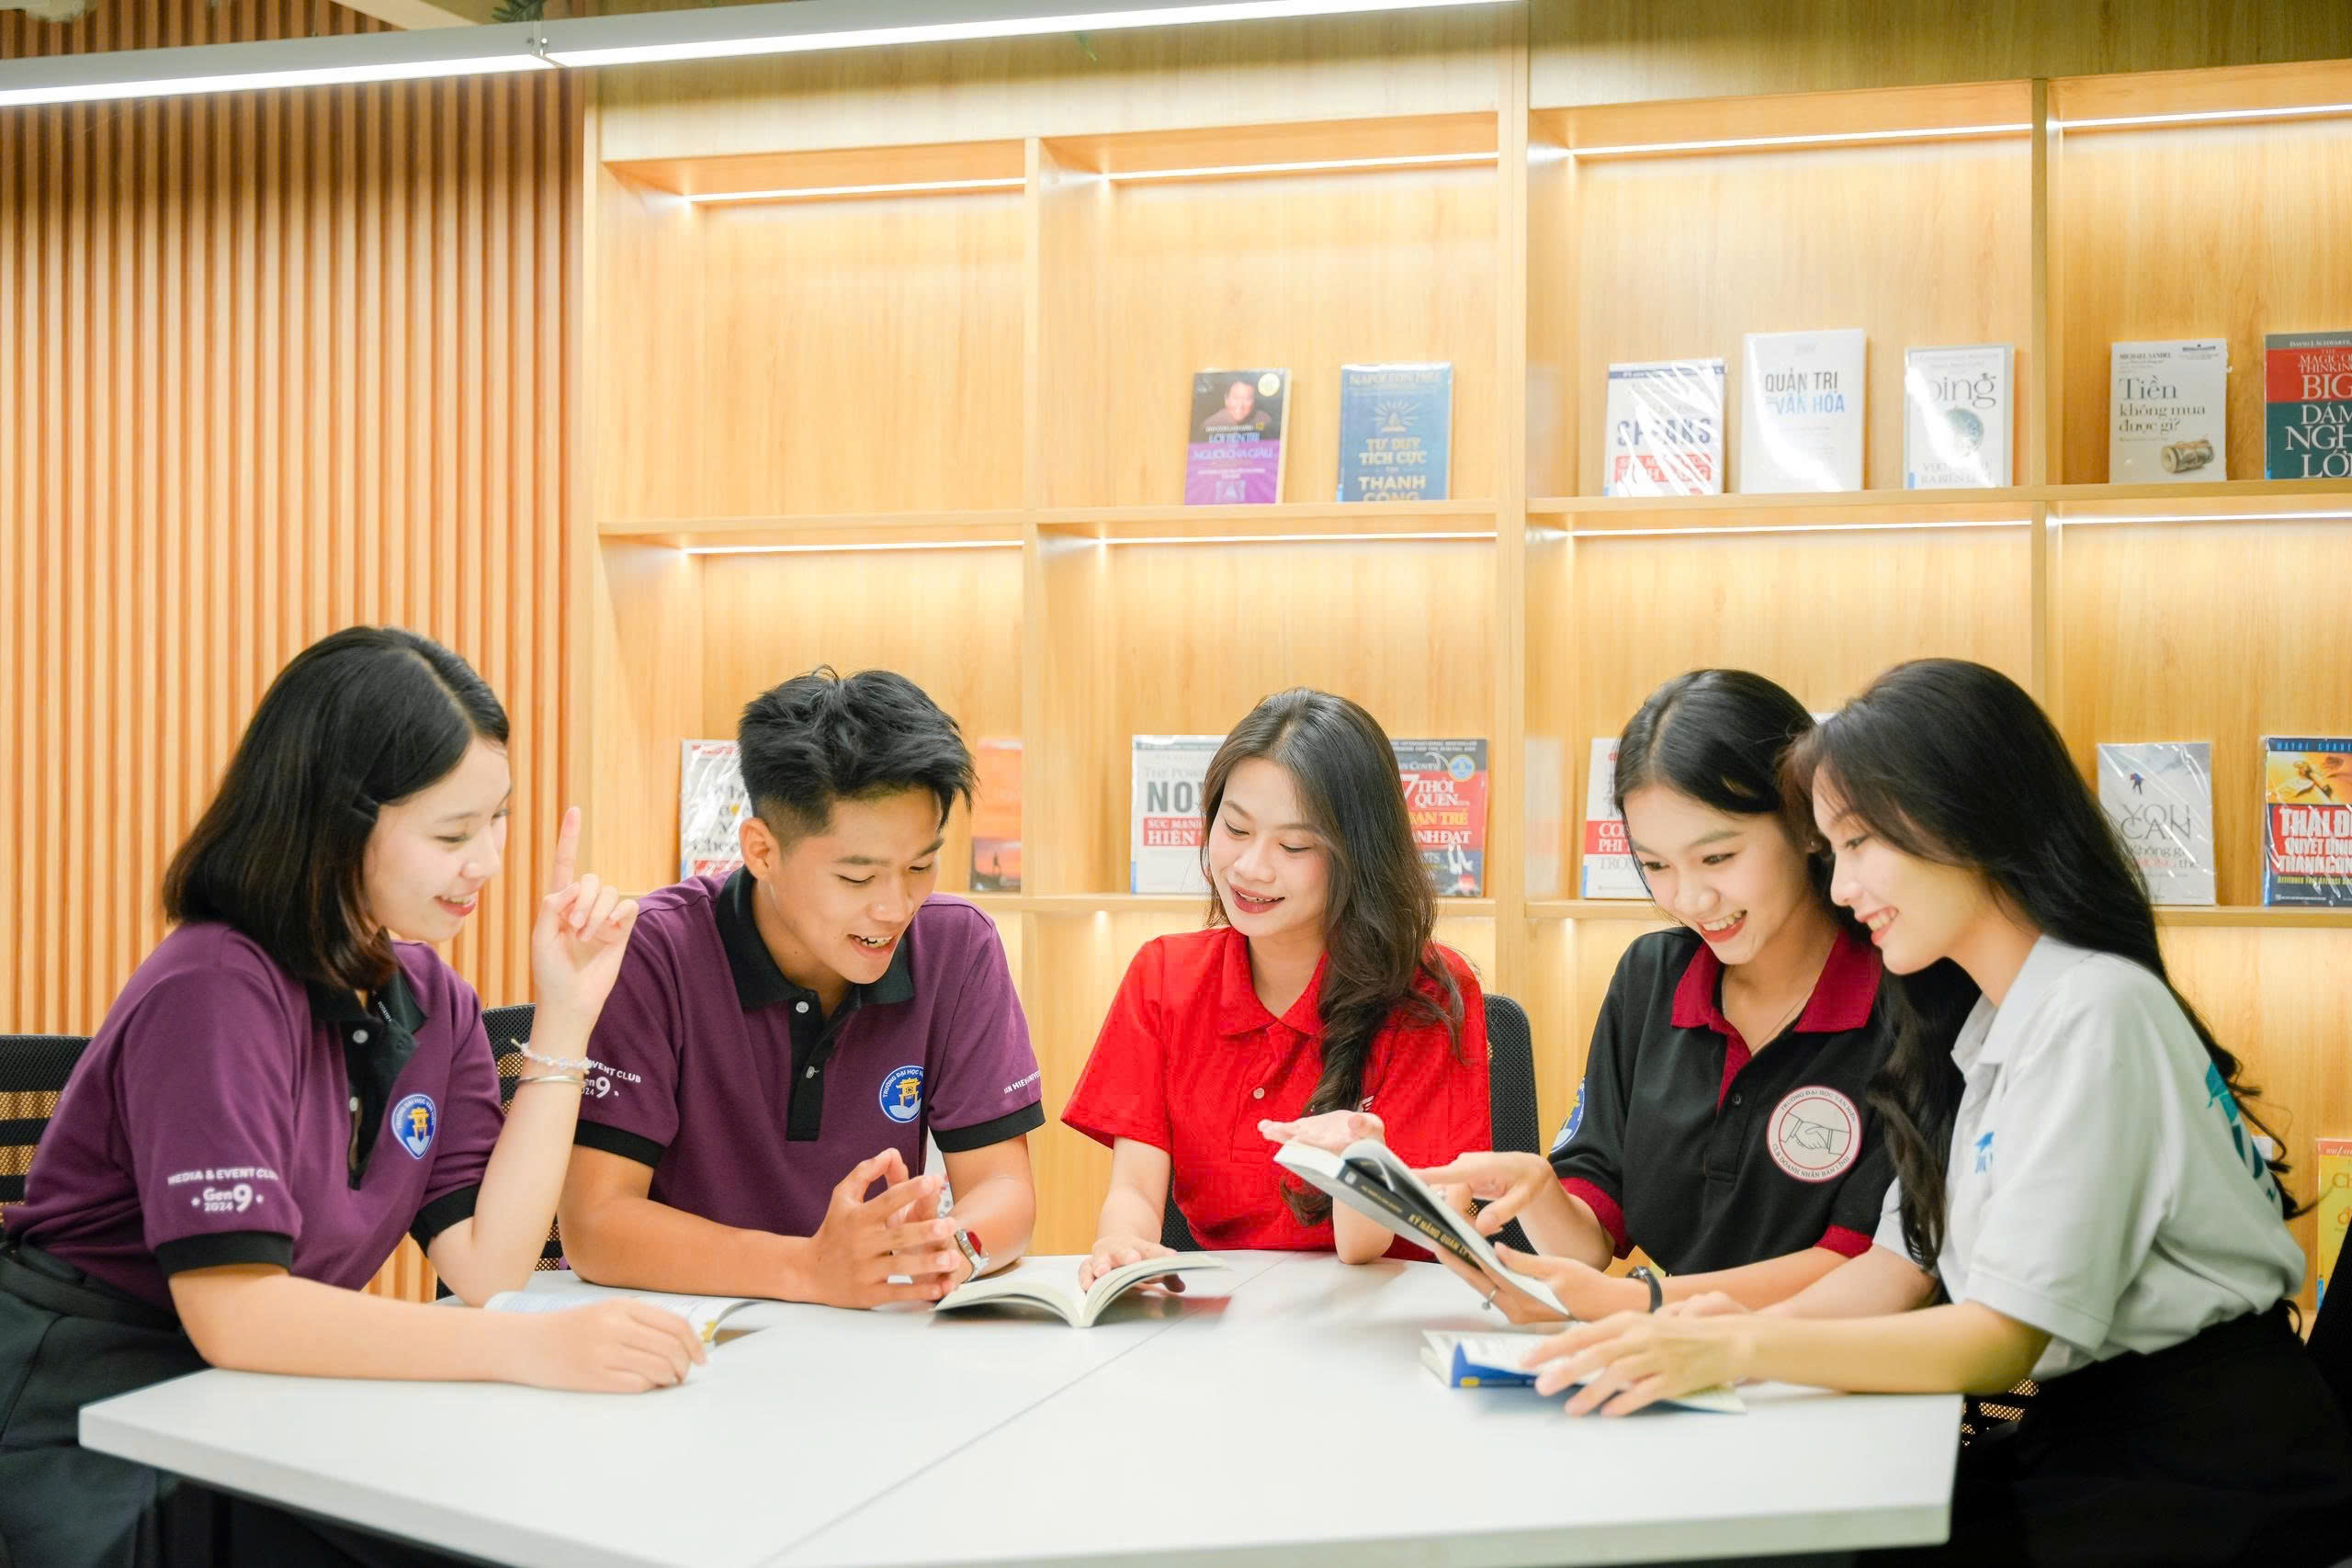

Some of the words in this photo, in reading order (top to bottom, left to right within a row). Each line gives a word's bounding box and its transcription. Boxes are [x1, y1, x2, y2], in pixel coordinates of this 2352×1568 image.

[2119, 375, 2178, 400] Tiền
[2120, 402, 2167, 419] không
[2171, 405, 2205, 416] mua
[1401, 773, 1419, 800] 7
[2122, 803, 2190, 825] YOU
[1599, 822, 1625, 838] CO
[2120, 817, 2191, 840] CAN
[615, 1069, 642, 1084] CLUB
[167, 1169, 204, 1187] MEDIA
[205, 1168, 215, 1181] &
[216, 1167, 255, 1180] EVENT
[203, 1201, 234, 1213] 2024
